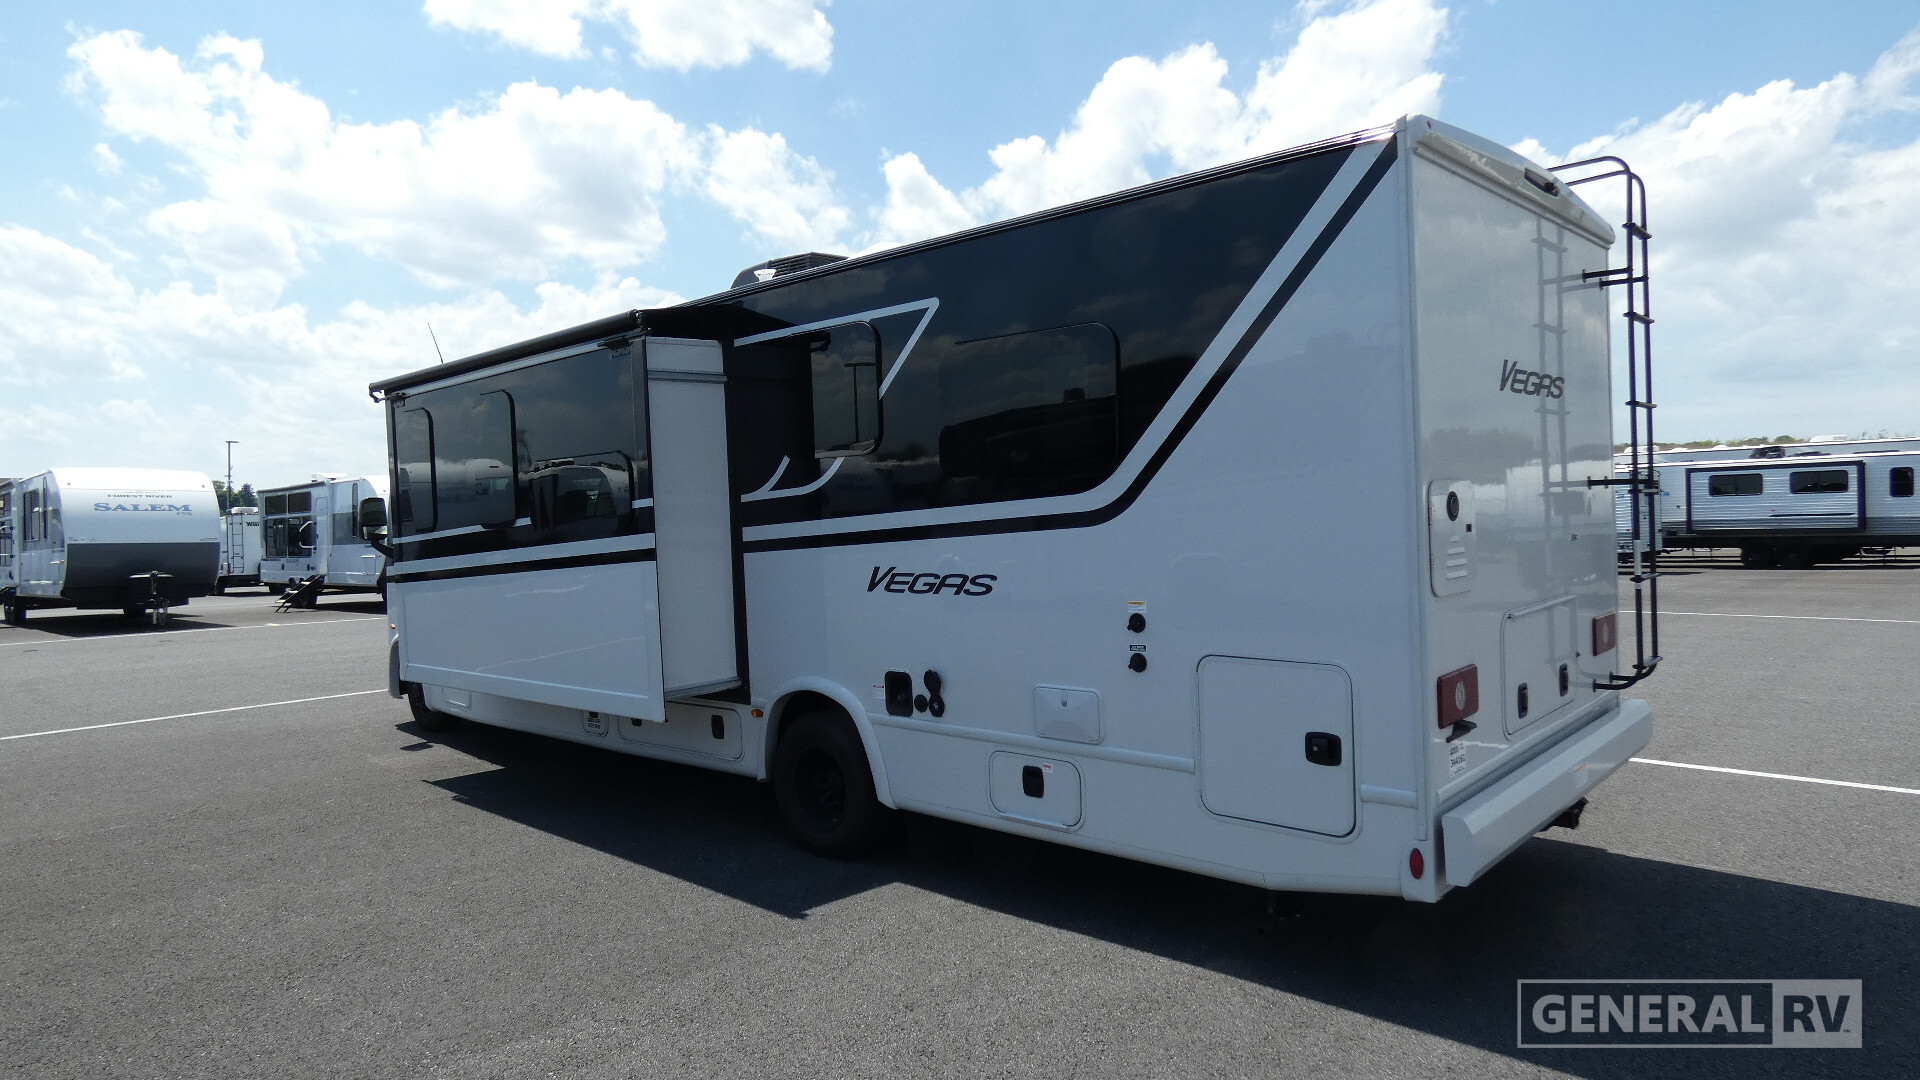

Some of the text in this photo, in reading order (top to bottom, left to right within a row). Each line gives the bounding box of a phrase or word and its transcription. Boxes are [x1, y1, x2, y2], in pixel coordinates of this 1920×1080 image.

[1499, 359, 1565, 399] VEGAS
[94, 502, 192, 512] SALEM
[866, 566, 998, 597] VEGAS
